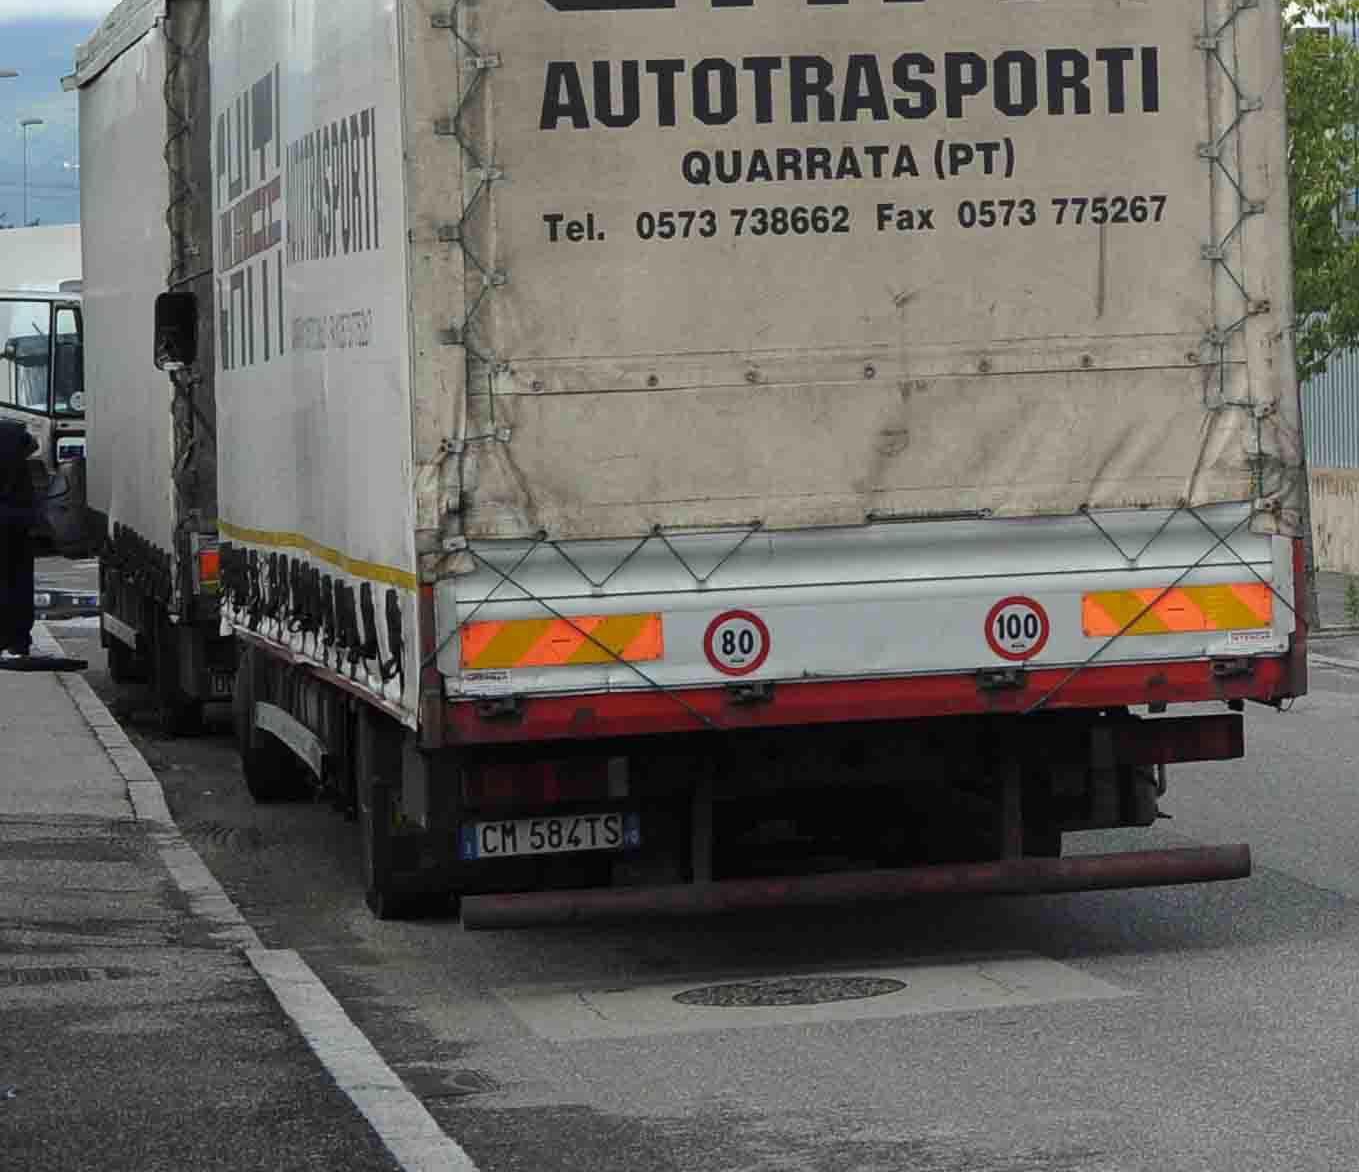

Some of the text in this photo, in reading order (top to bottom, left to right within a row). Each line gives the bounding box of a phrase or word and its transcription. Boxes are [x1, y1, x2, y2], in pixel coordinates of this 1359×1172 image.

[540, 46, 1160, 130] AUTOTRASPORTI
[682, 137, 1015, 185] QUARRATA (PT)
[284, 105, 380, 268] TRASPORTI
[543, 195, 1168, 244] Tel. 0573 738662 Fax 0573 775267
[722, 629, 754, 656] 80
[996, 613, 1039, 640] 100
[481, 823, 518, 854] CM
[529, 815, 620, 850] 584TS
